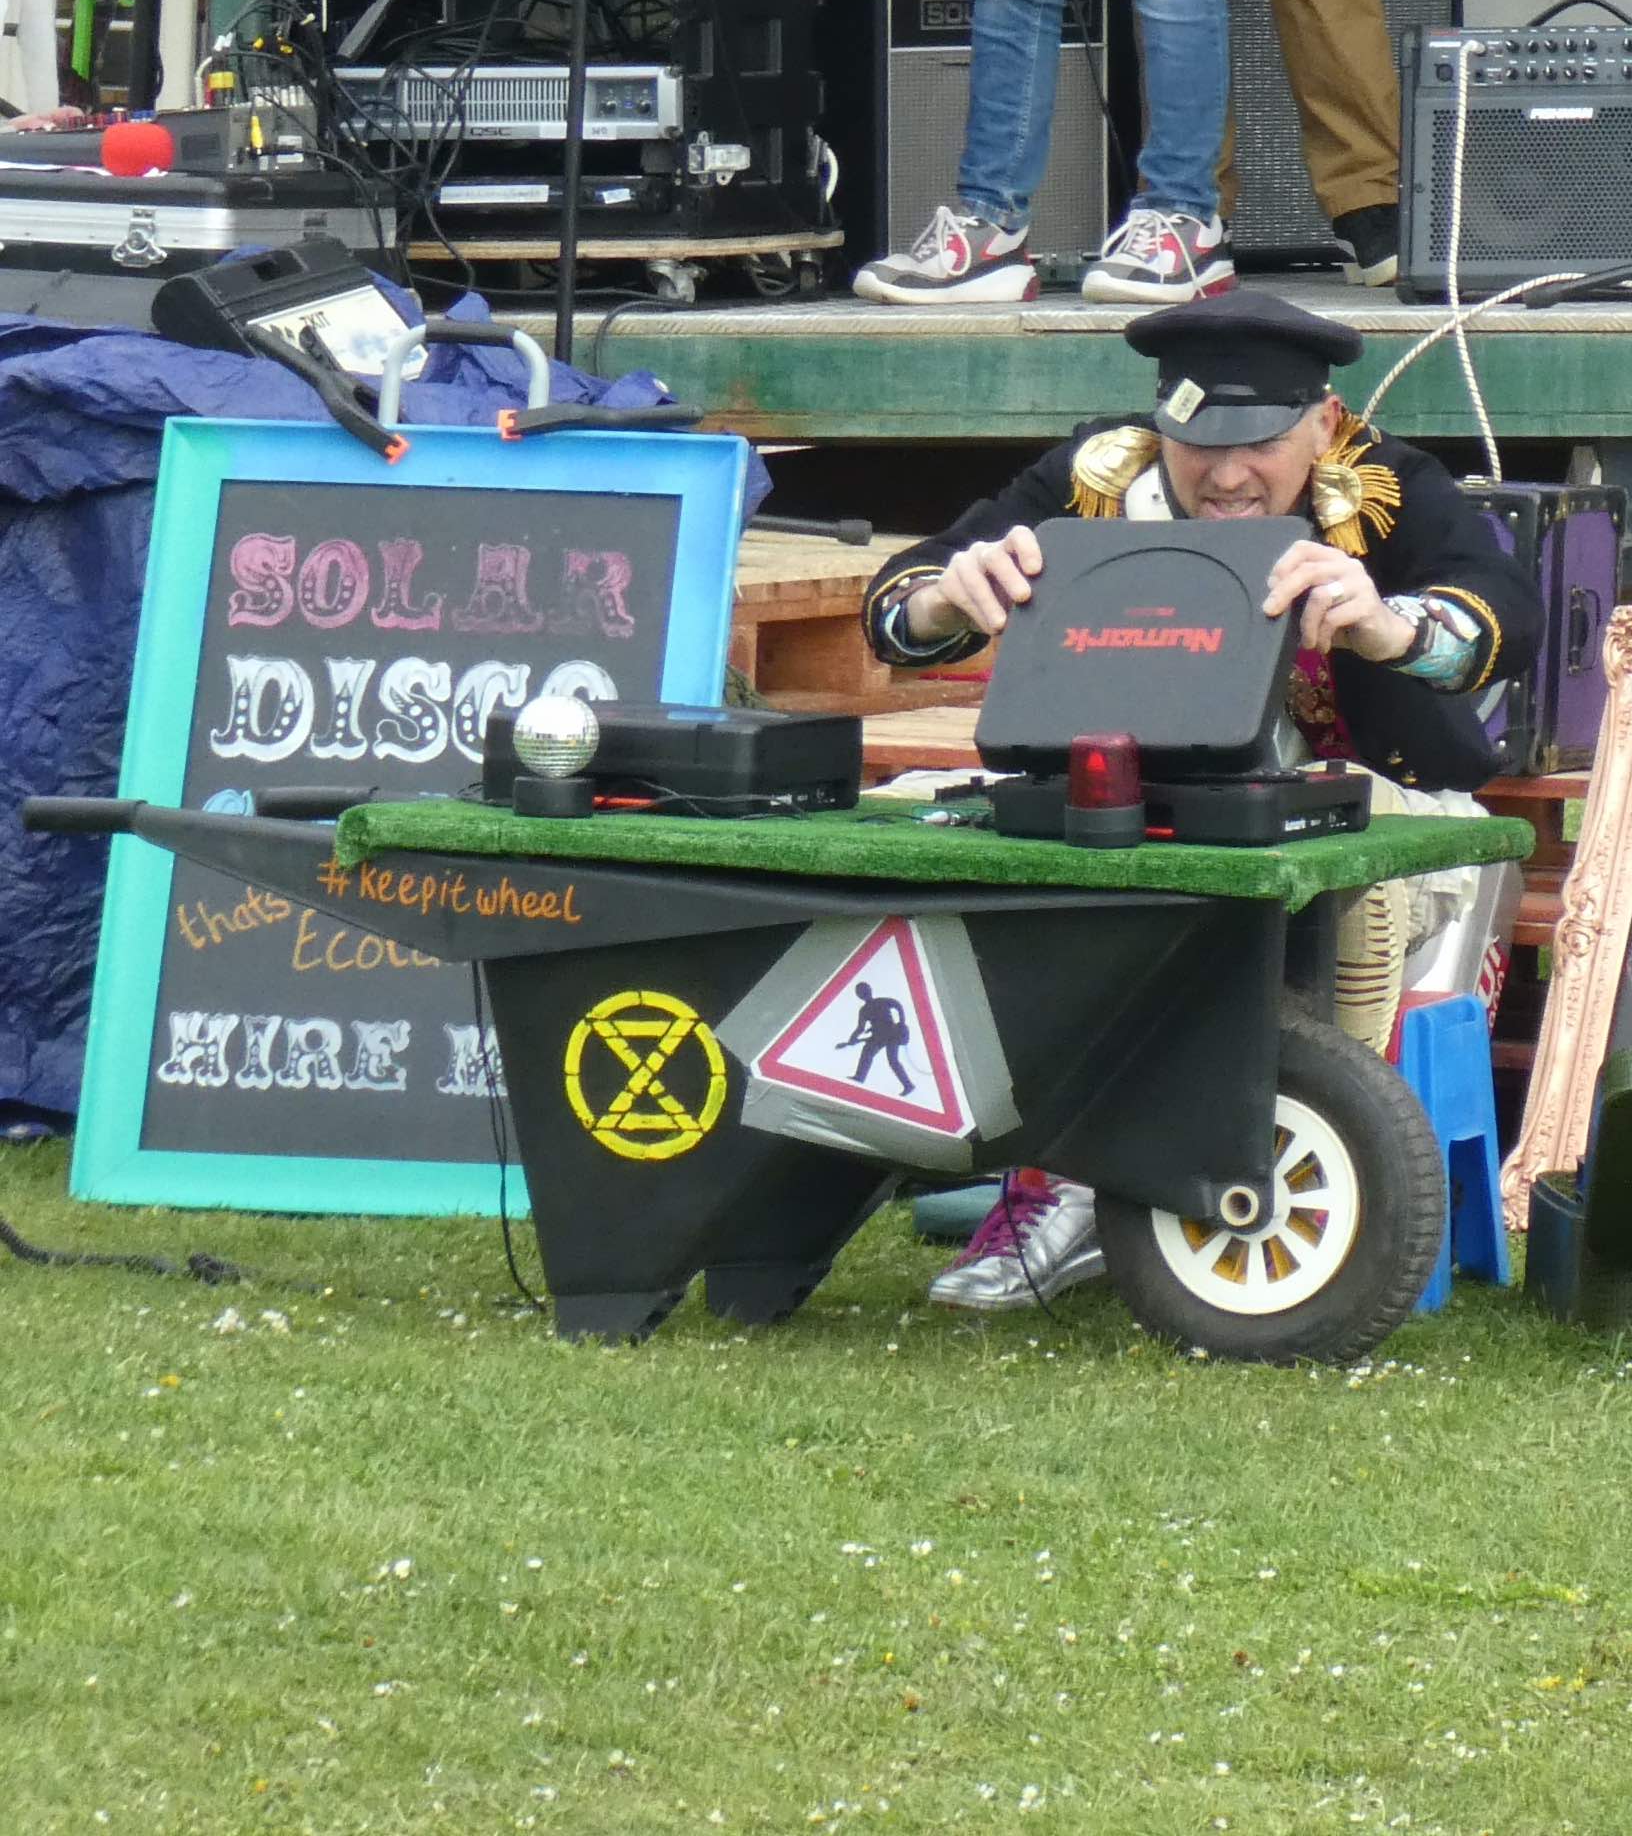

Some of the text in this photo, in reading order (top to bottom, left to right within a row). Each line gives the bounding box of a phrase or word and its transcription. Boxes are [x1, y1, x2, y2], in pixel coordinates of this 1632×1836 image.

[470, 125, 513, 137] QSC
[228, 531, 636, 639] SOLAR
[1061, 627, 1225, 654] Numark
[175, 885, 292, 950] thats
[156, 1010, 412, 1093] HIRE
